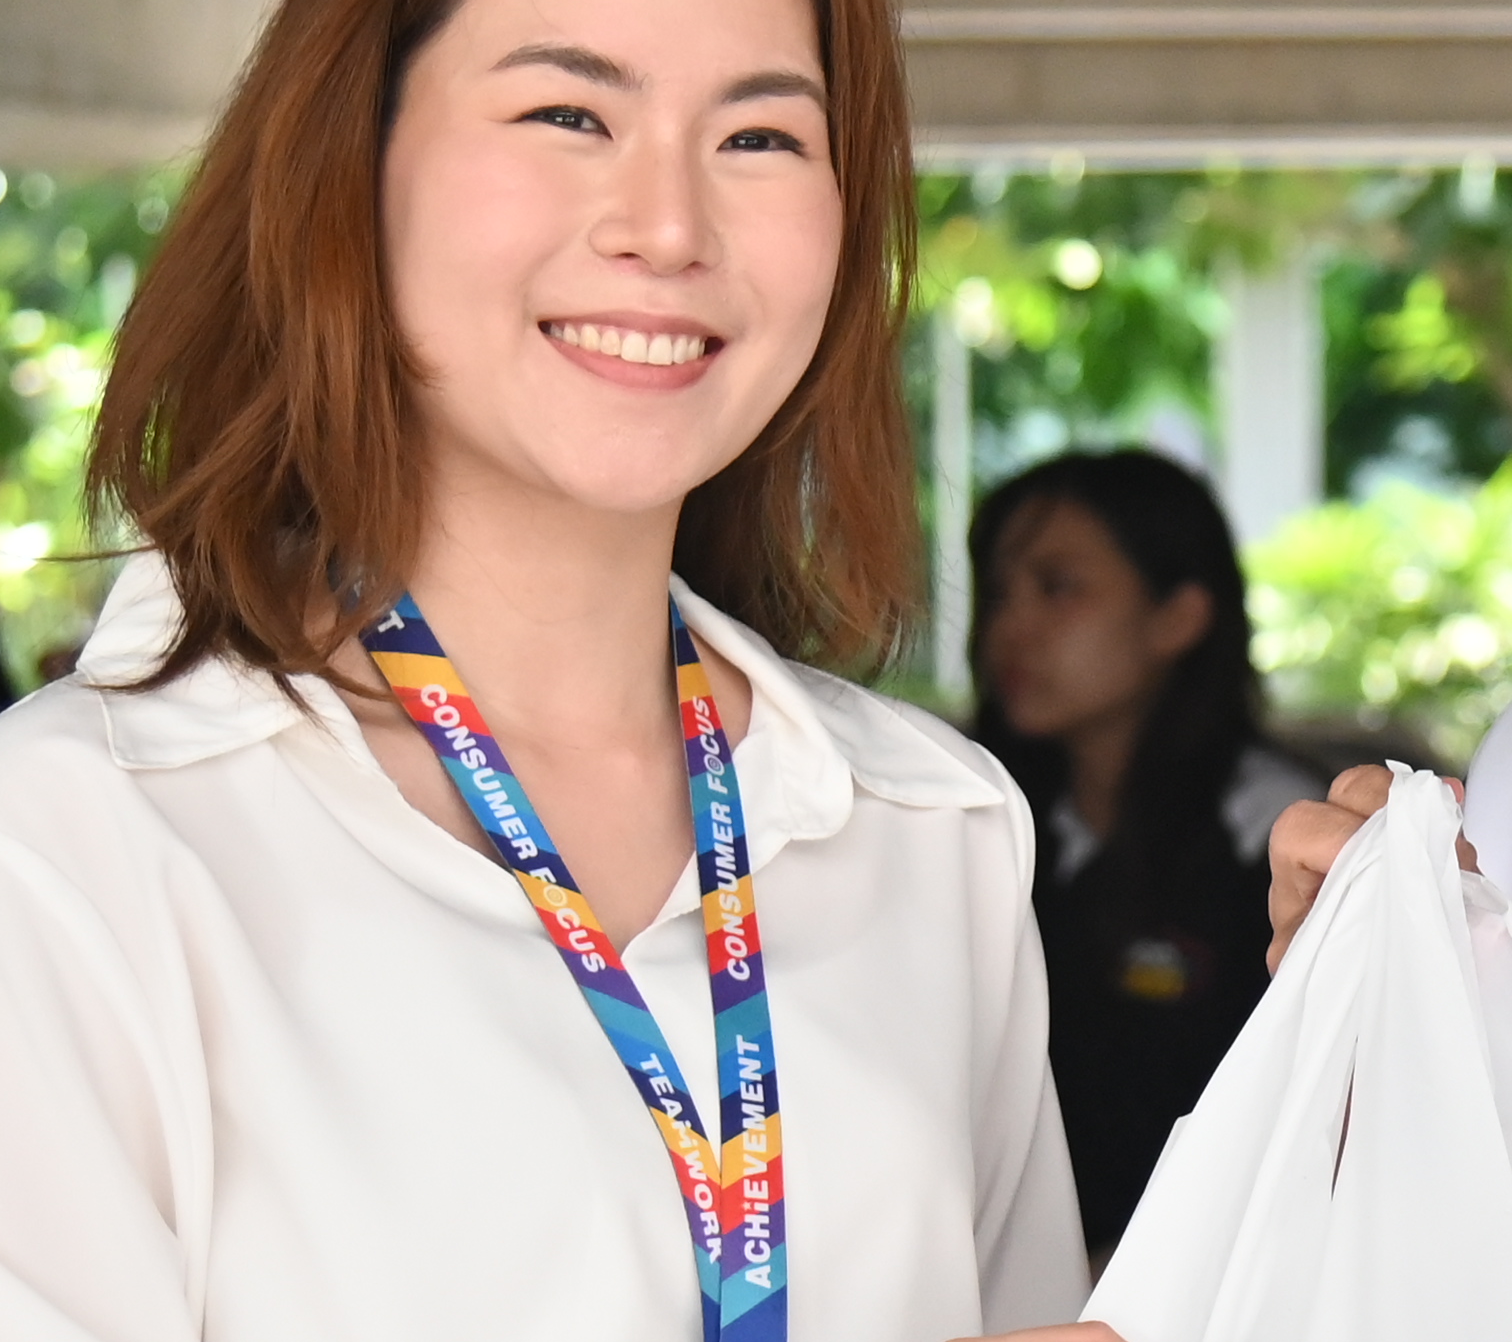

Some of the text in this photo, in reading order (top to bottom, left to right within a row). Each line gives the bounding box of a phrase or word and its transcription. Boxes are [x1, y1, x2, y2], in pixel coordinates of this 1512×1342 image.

[420, 683, 607, 983] CONSUMER FOCUS
[692, 695, 750, 982] CONSUMER FOCUS
[640, 1052, 722, 1264] TEAMWORK
